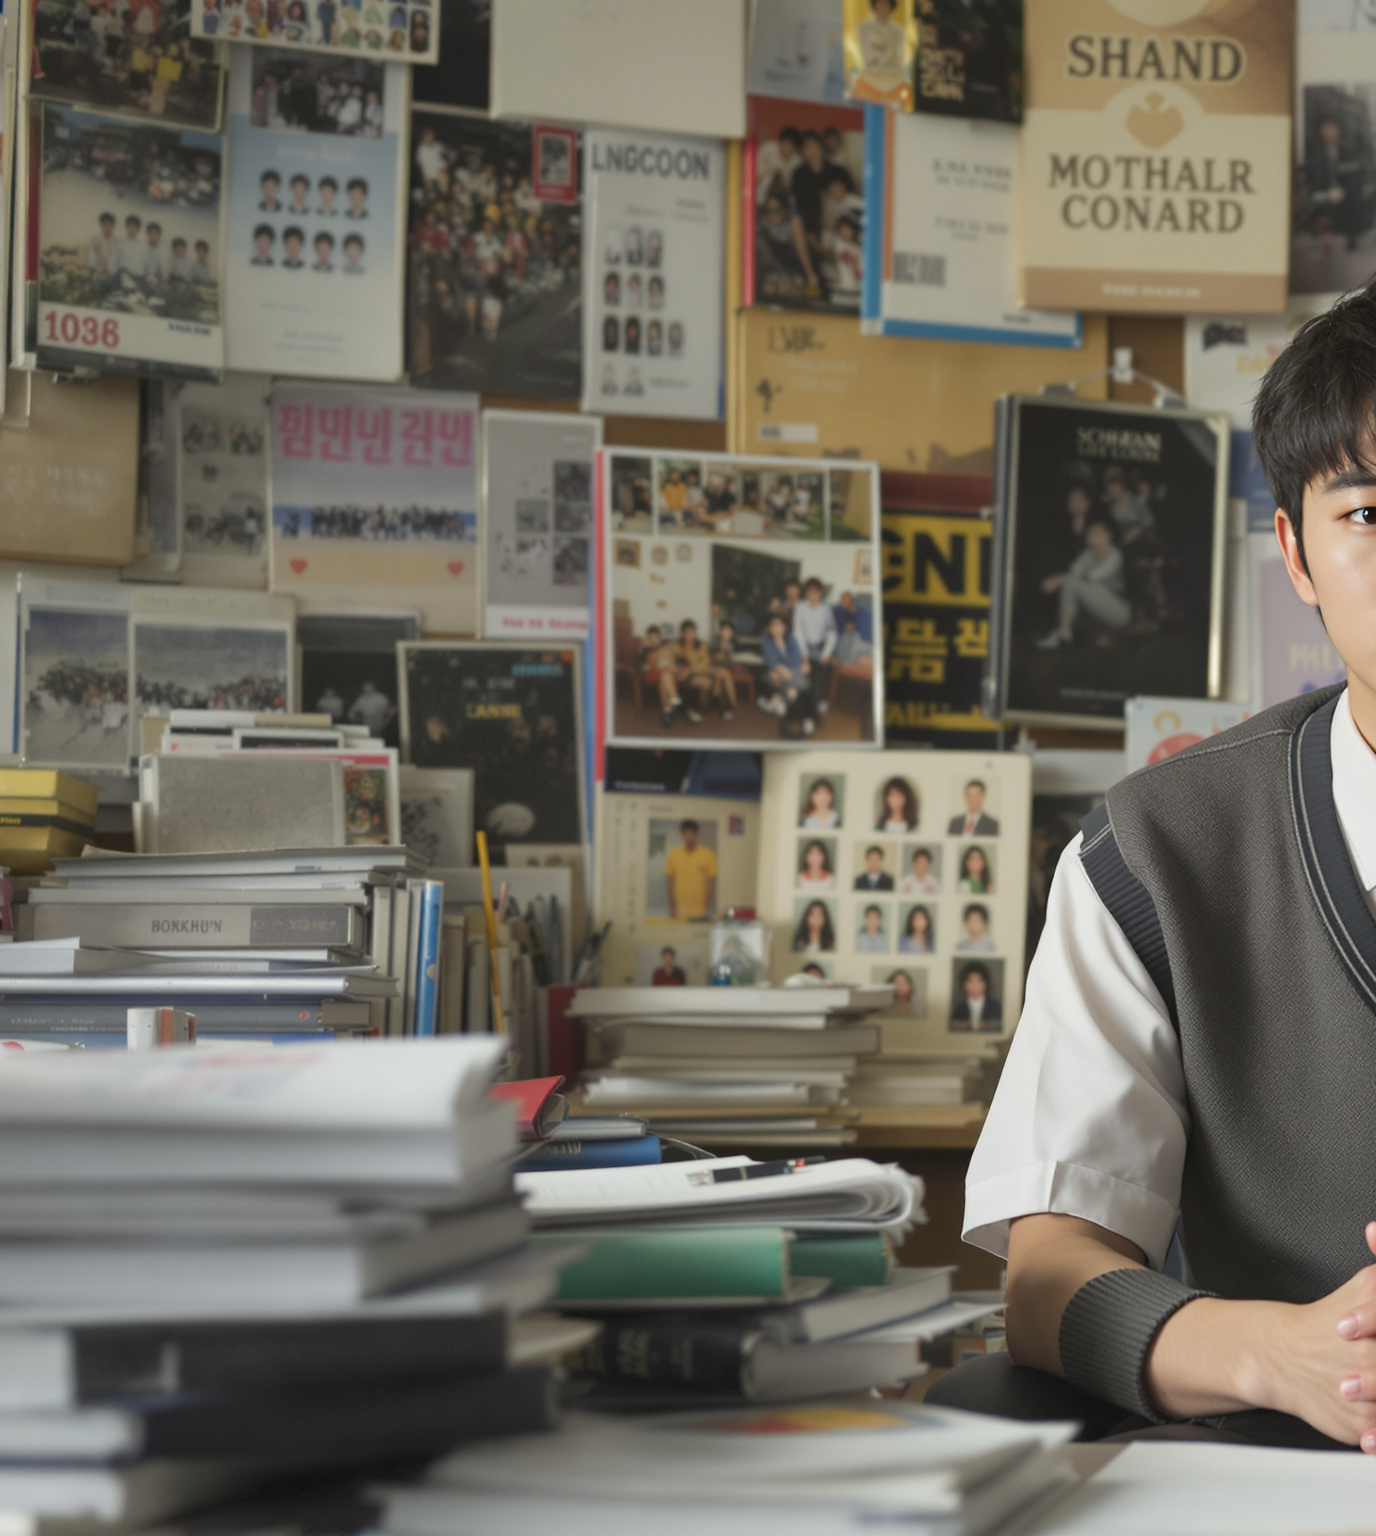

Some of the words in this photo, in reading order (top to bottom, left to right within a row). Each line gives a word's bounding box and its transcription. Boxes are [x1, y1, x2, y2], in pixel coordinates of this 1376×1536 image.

[1067, 35, 1243, 82] SHAND
[1048, 153, 1255, 196] MOTHALR
[1061, 194, 1244, 234] CONARD
